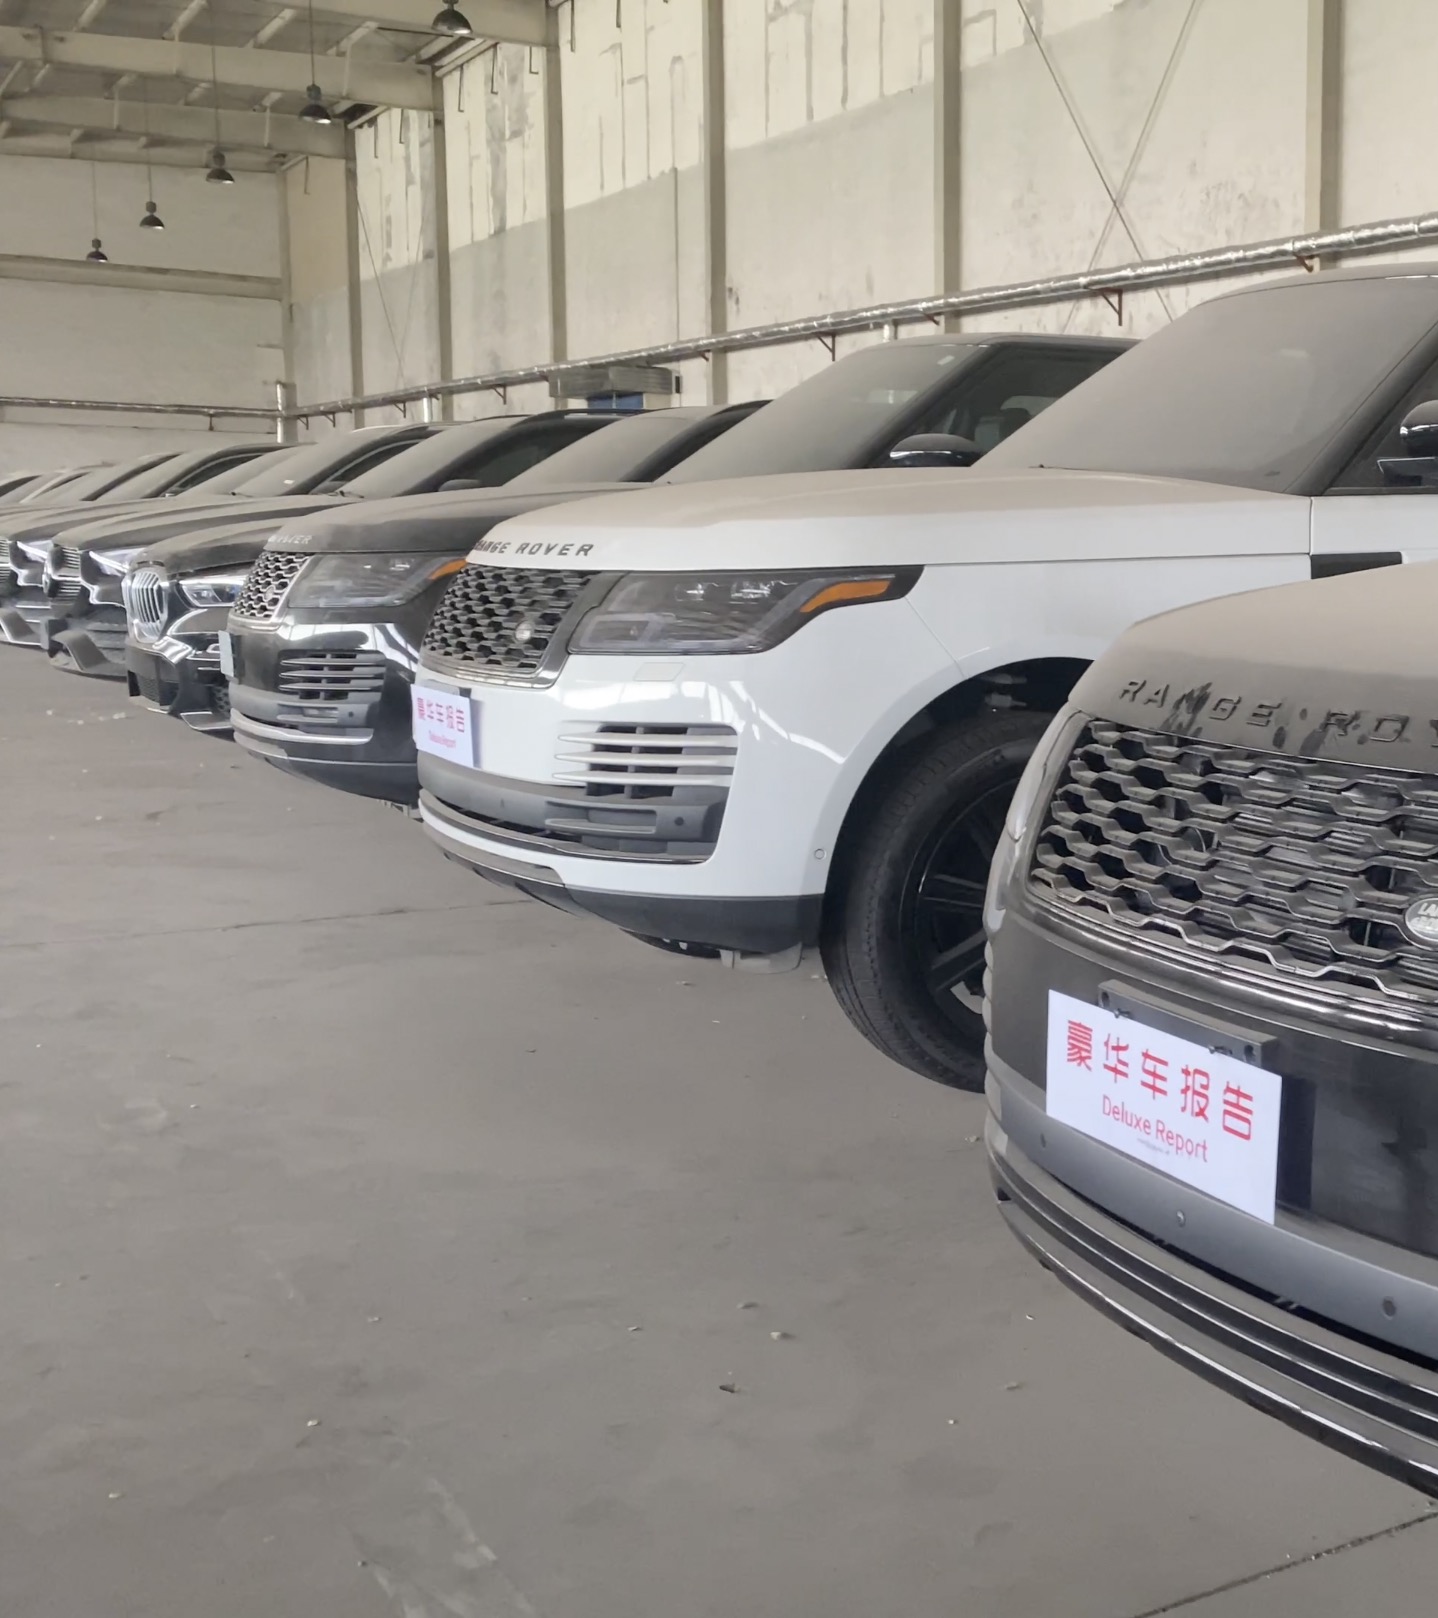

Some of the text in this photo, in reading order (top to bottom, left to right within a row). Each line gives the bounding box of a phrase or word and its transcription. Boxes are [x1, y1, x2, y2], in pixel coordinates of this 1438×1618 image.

[515, 542, 594, 556] ROVER
[1066, 1019, 1254, 1141] 豪华车报告
[1102, 1094, 1152, 1135] Deluxe
[1155, 1119, 1208, 1163] Report
